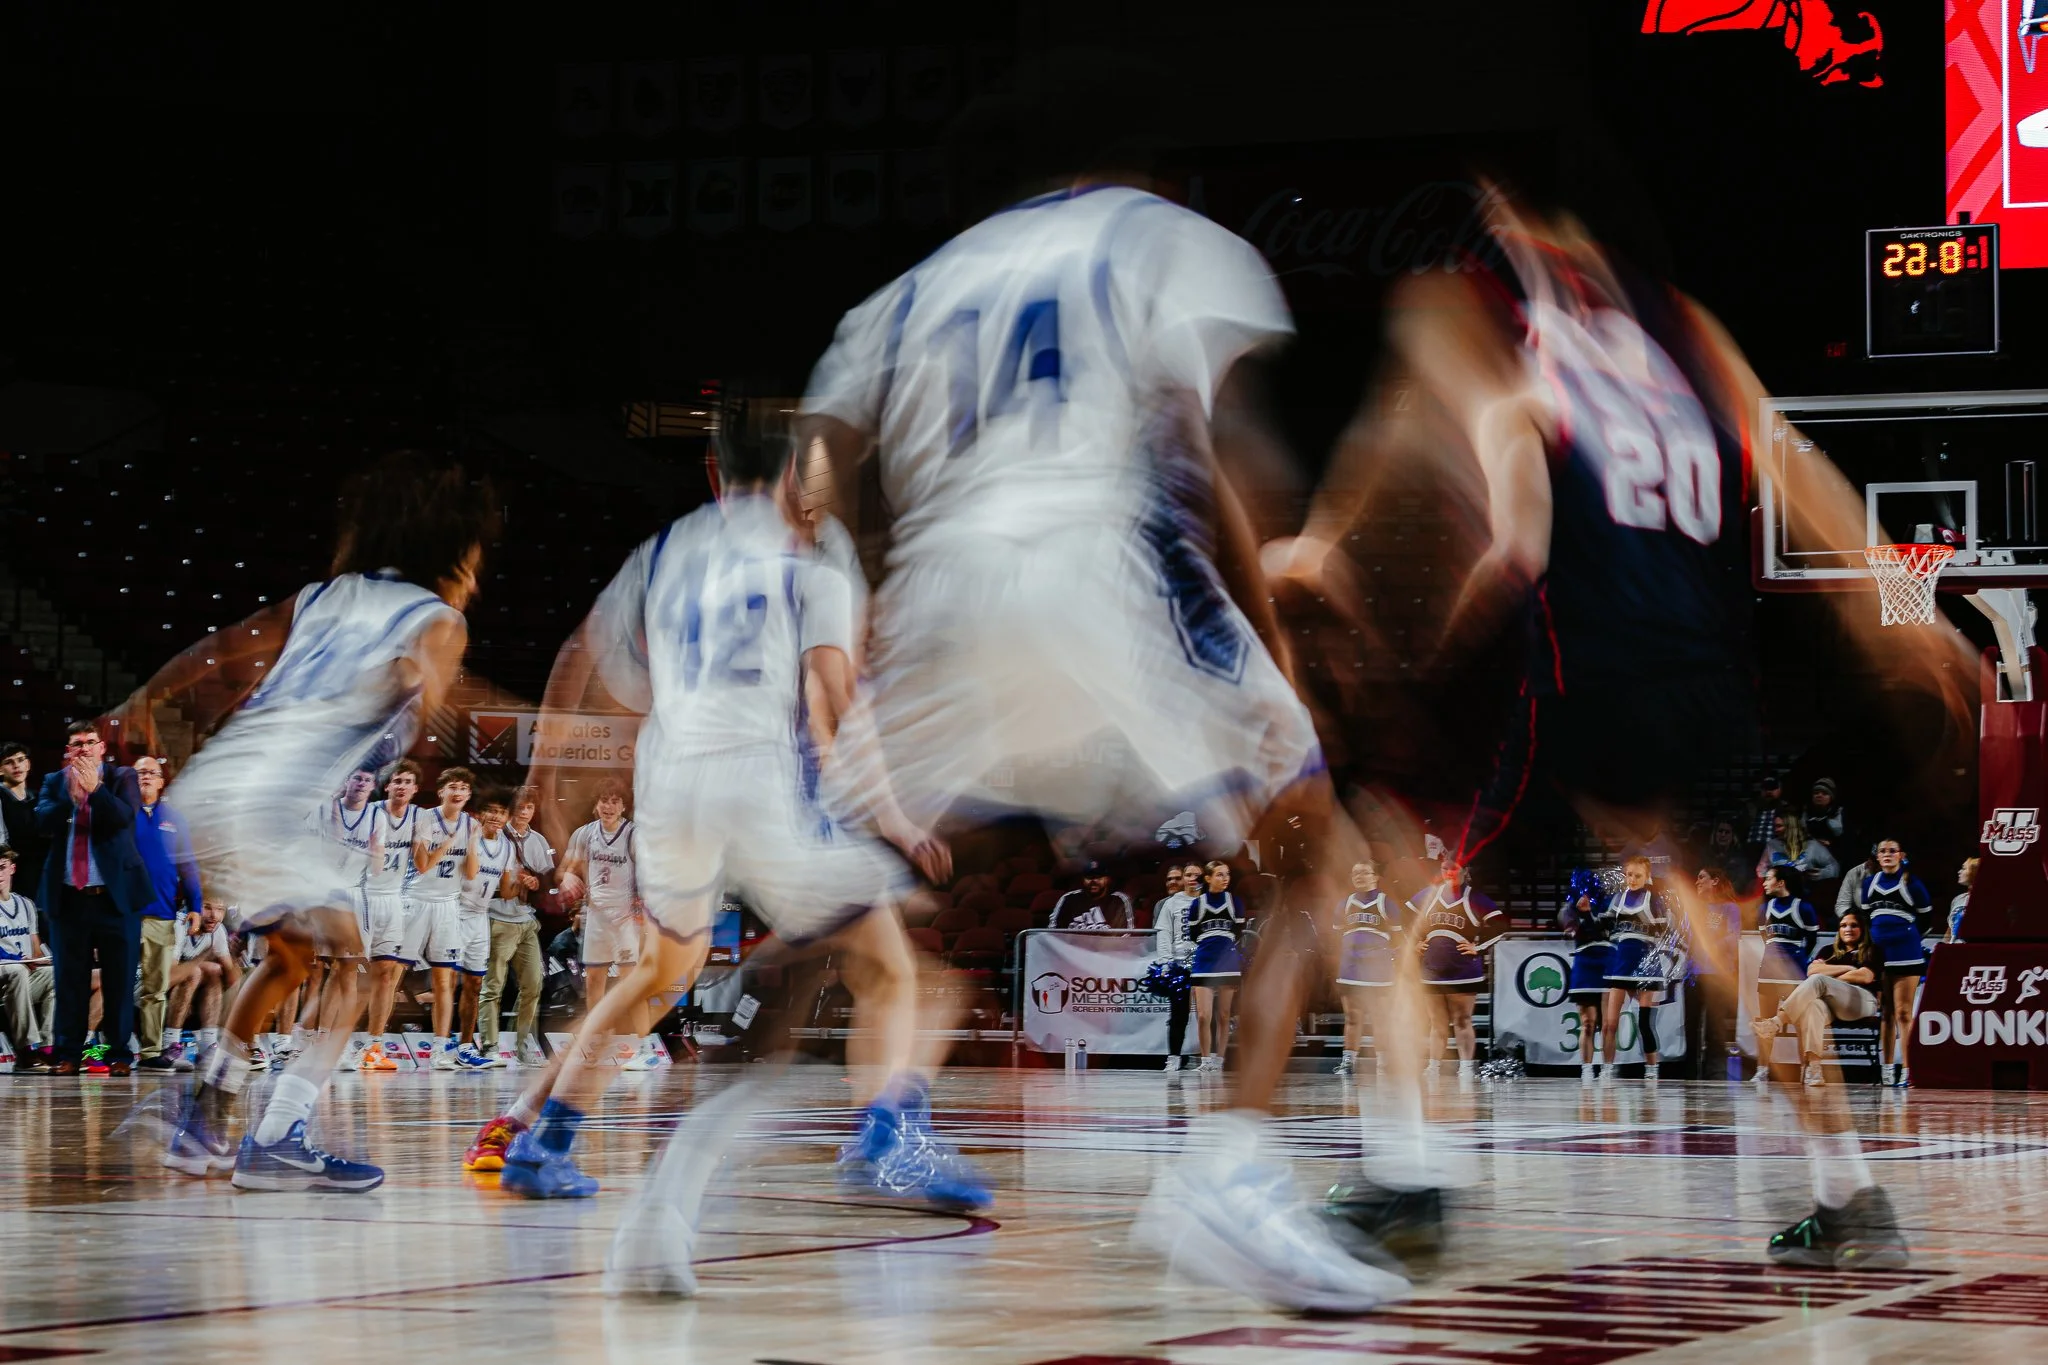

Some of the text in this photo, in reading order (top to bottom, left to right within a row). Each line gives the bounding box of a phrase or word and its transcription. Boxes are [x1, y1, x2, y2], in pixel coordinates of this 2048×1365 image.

[1900, 230, 1963, 240] DAKTRONICS
[1603, 426, 1722, 546] 20
[436, 859, 455, 879] 12
[1919, 1009, 2048, 1046] DUNK
